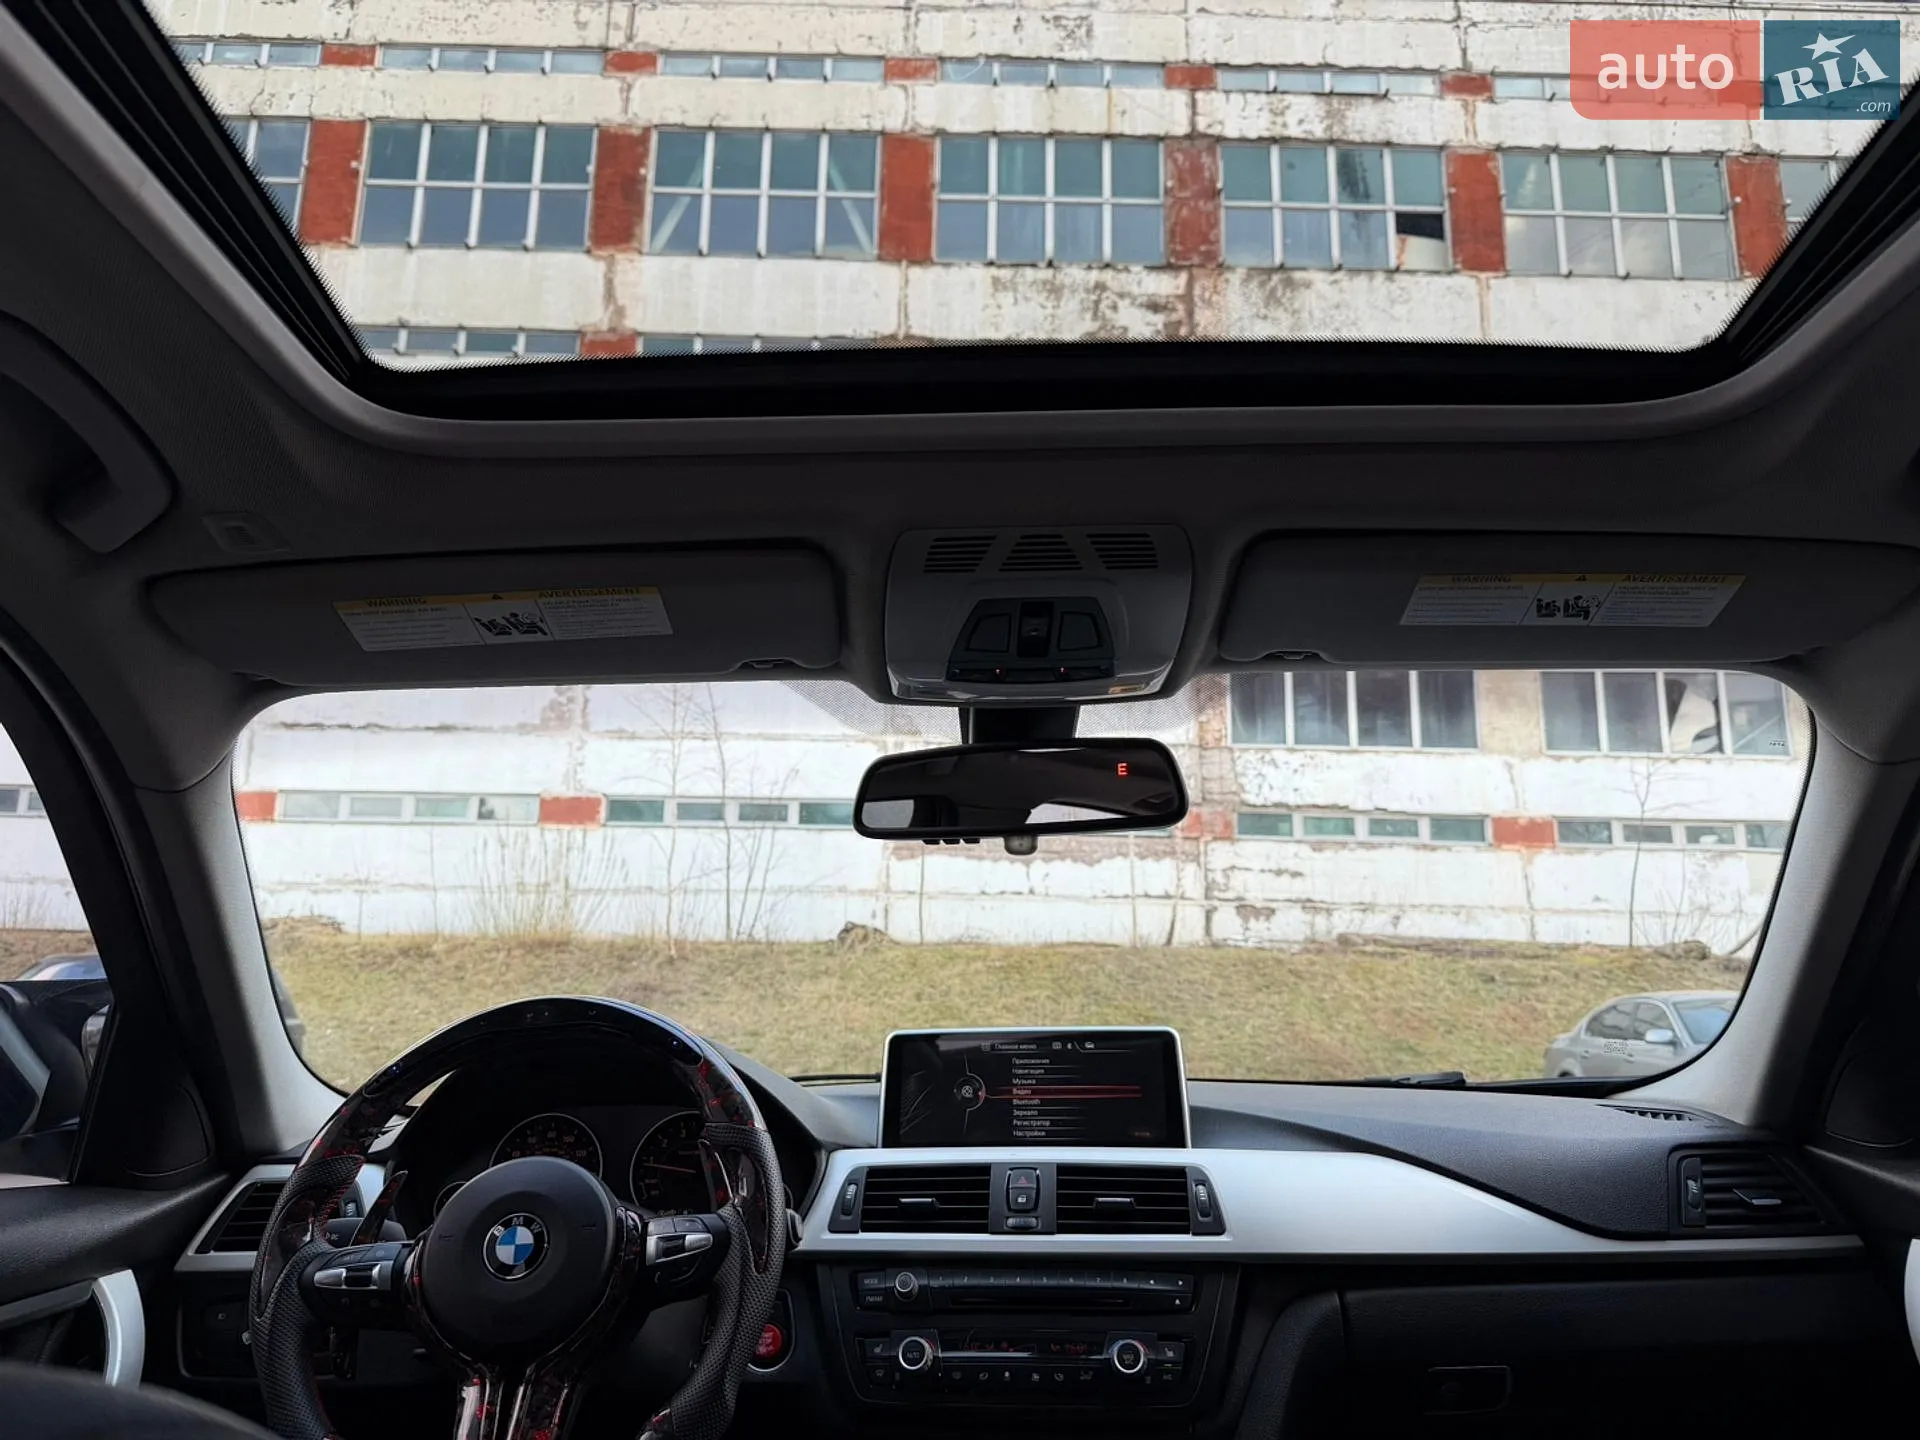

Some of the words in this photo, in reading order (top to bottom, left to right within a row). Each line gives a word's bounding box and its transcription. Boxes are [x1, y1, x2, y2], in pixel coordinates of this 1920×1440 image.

[367, 597, 428, 608] WARNING
[1117, 762, 1128, 776] E
[1013, 1119, 1051, 1127] Регистратор
[1013, 1129, 1047, 1137] Настройки
[493, 1215, 542, 1237] BMW
